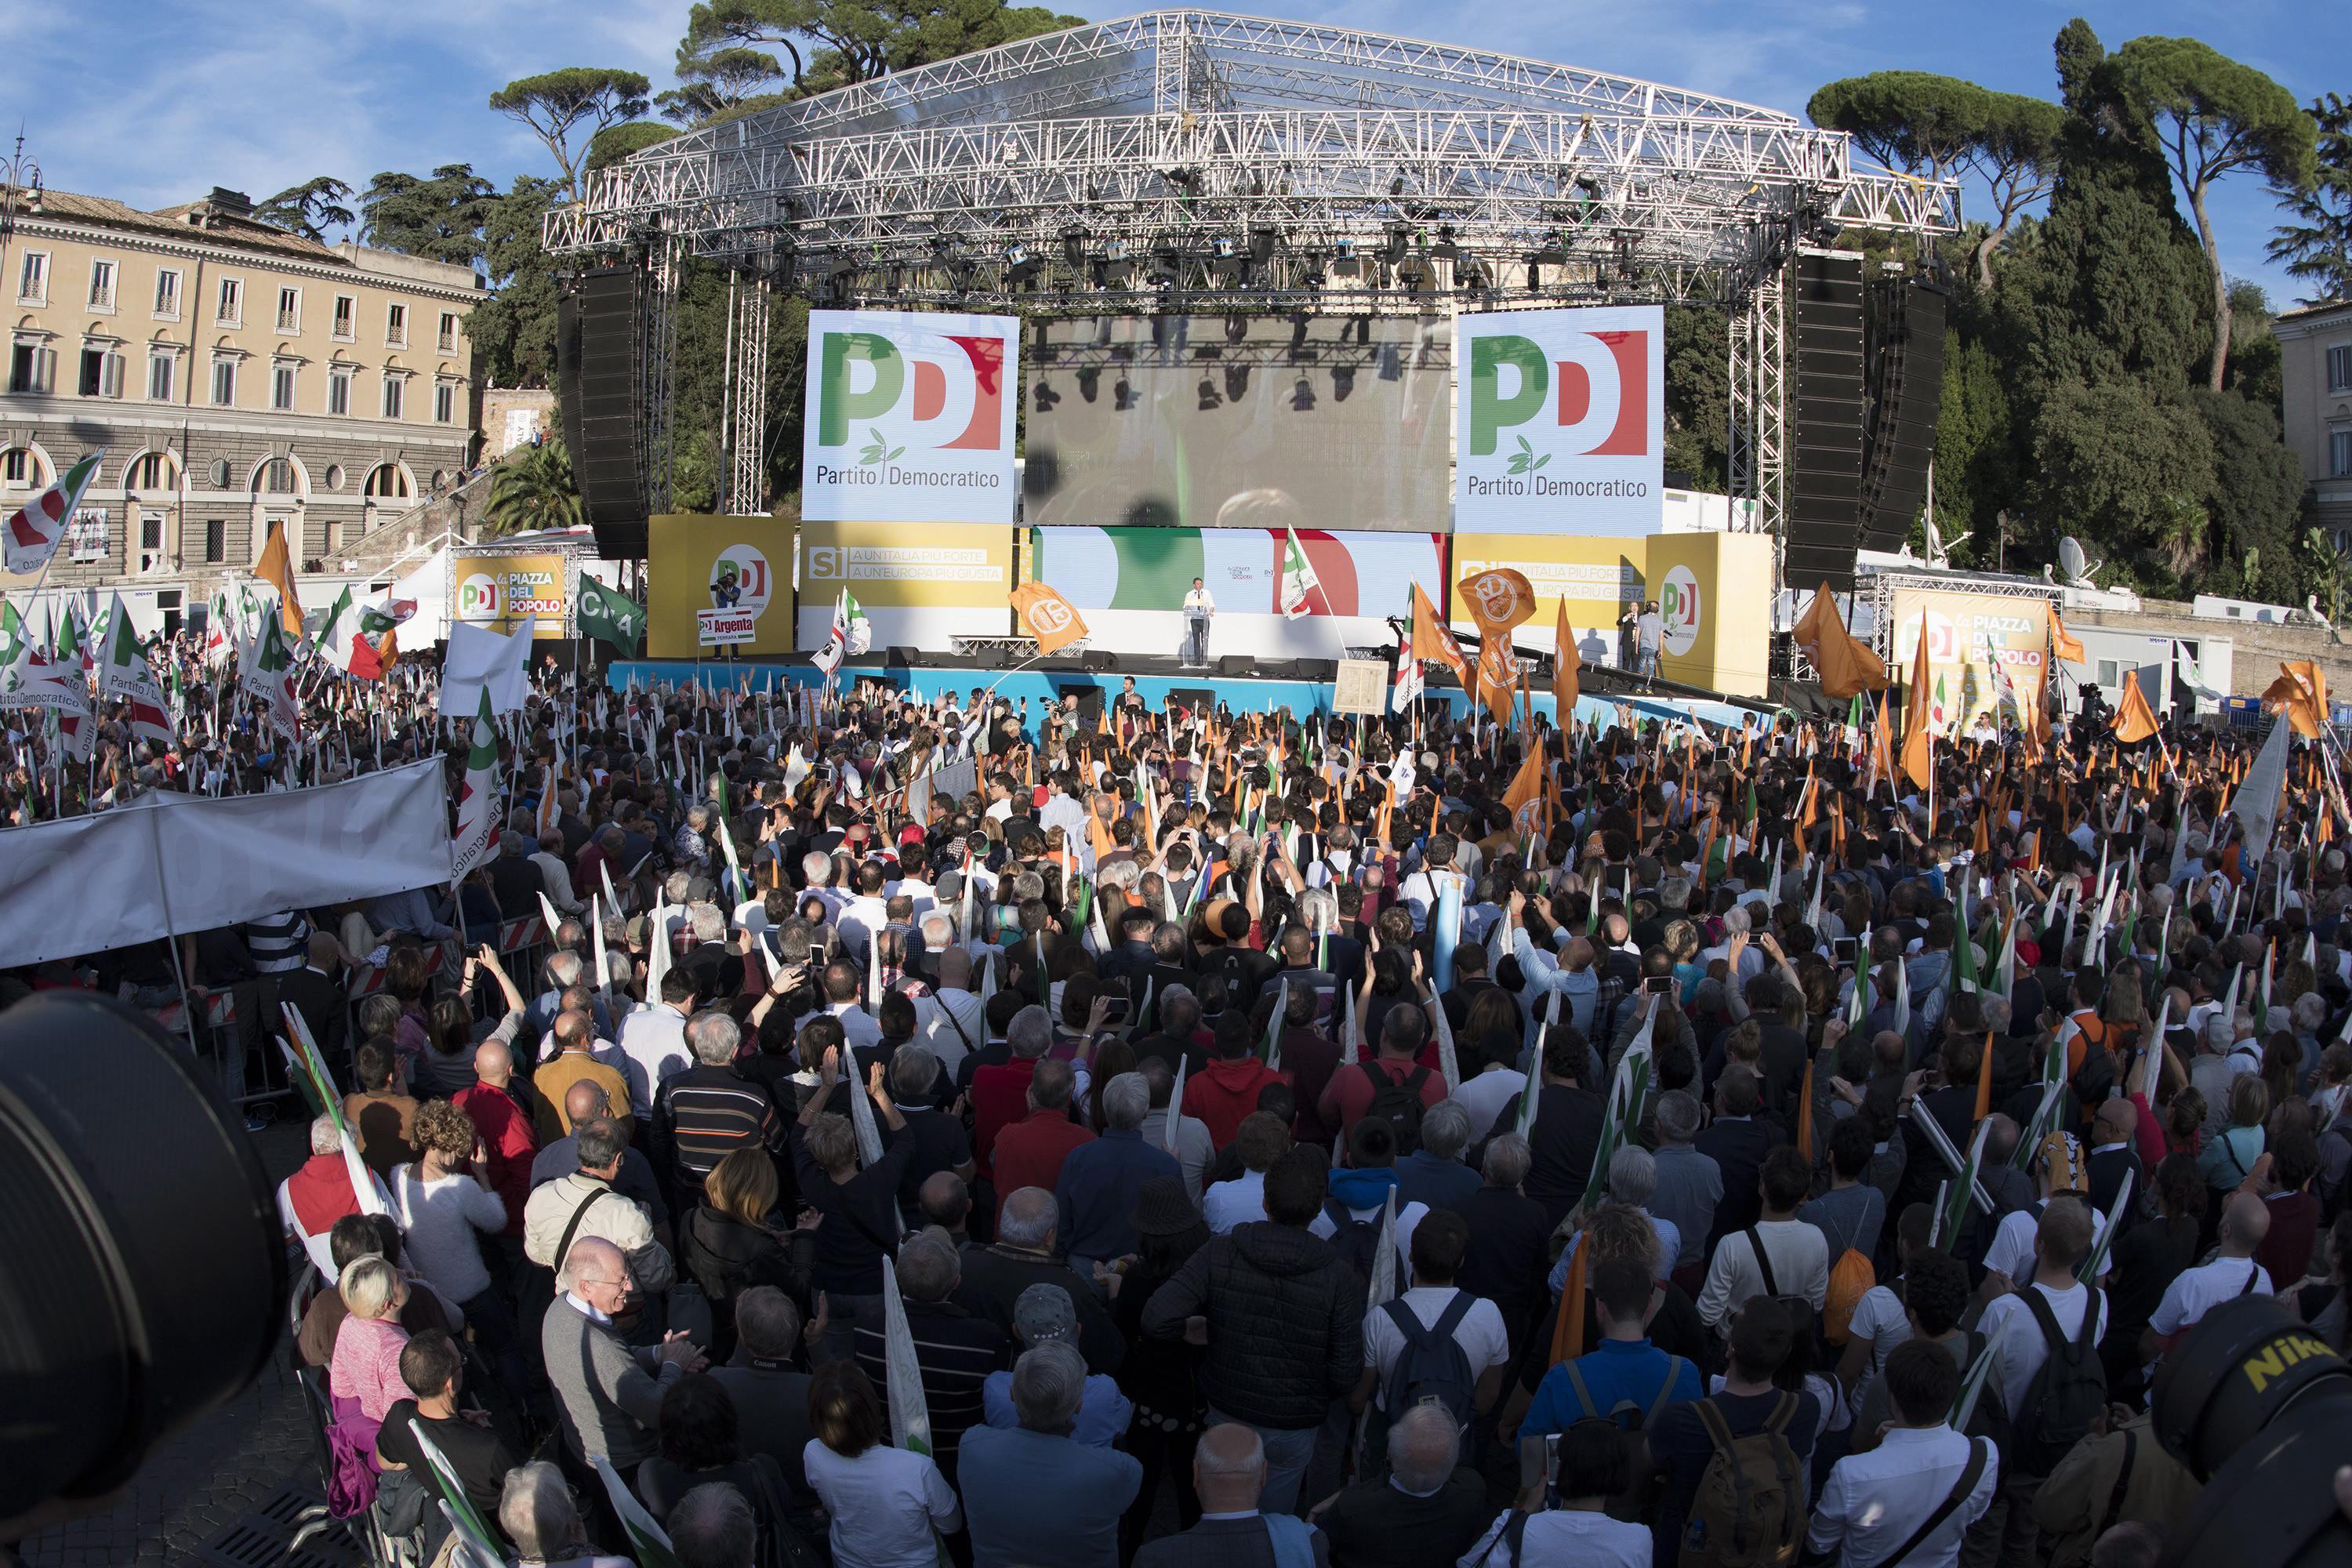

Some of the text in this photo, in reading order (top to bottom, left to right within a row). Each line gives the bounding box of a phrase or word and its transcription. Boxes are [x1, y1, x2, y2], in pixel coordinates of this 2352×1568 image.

[819, 332, 1004, 450] PD
[1470, 330, 1648, 456] PD
[818, 466, 999, 487] Partito Democratico
[1468, 476, 1647, 497] Partito Democratico
[812, 546, 843, 577] SÌ
[853, 550, 862, 560] A
[864, 550, 920, 561] UN'ITALIA
[944, 551, 982, 562] FORTE
[496, 572, 553, 584] la PIAZZA
[853, 568, 862, 577] A
[864, 567, 932, 578] UN'EUROPA
[957, 568, 999, 579] GIUSTA
[1590, 568, 1629, 580] FORTE
[463, 584, 495, 610] PD
[510, 586, 532, 598] DEL
[1604, 587, 1645, 599] GIUSTA
[509, 600, 561, 612] POPOLO
[1663, 583, 1696, 625] PD
[714, 618, 753, 633] Argenta
[1973, 615, 2032, 633] PIAZZA
[111, 675, 144, 695] Partito
[20, 692, 79, 708] Democratico
[753, 1359, 777, 1368] Canon
